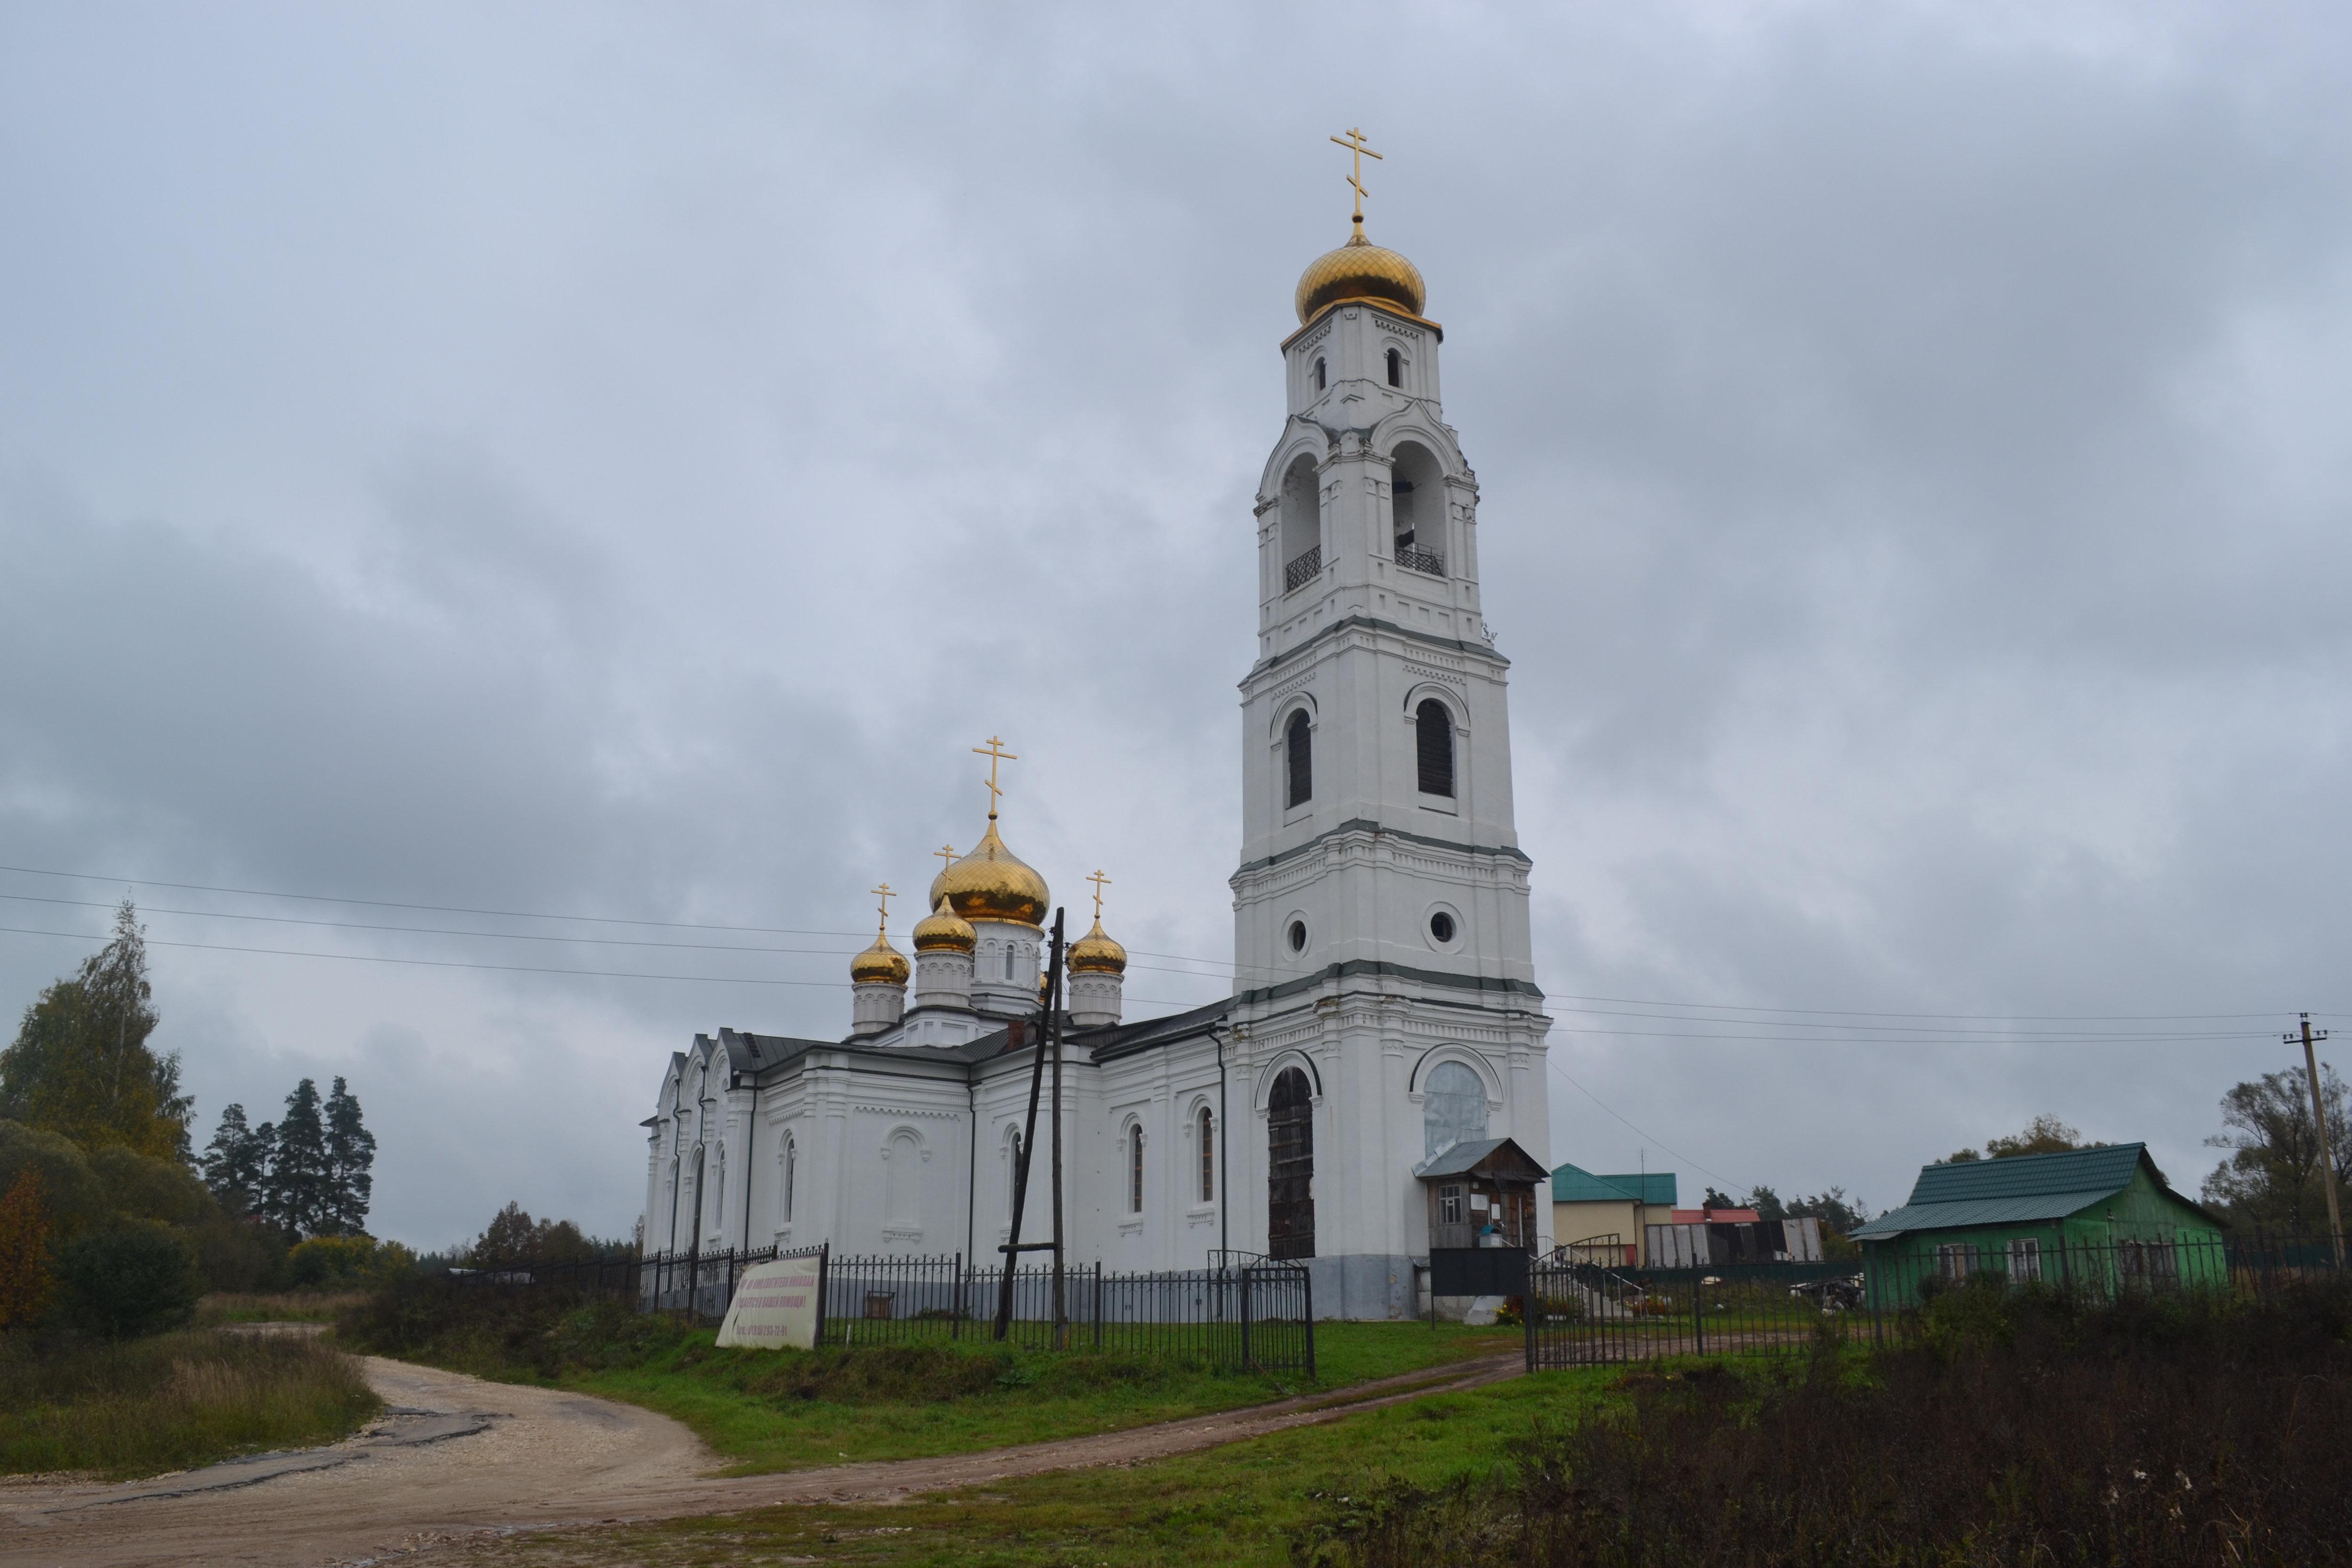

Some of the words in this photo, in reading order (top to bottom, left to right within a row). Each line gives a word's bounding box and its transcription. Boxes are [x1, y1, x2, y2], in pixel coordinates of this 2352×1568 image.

[763, 1277, 790, 1288] СВЯТИТЕЛЯ
[789, 1276, 815, 1287] НИКОЛАЯ
[762, 1294, 780, 1308] ВАШЕЙ
[780, 1295, 806, 1309] ПОМОЩИ!
